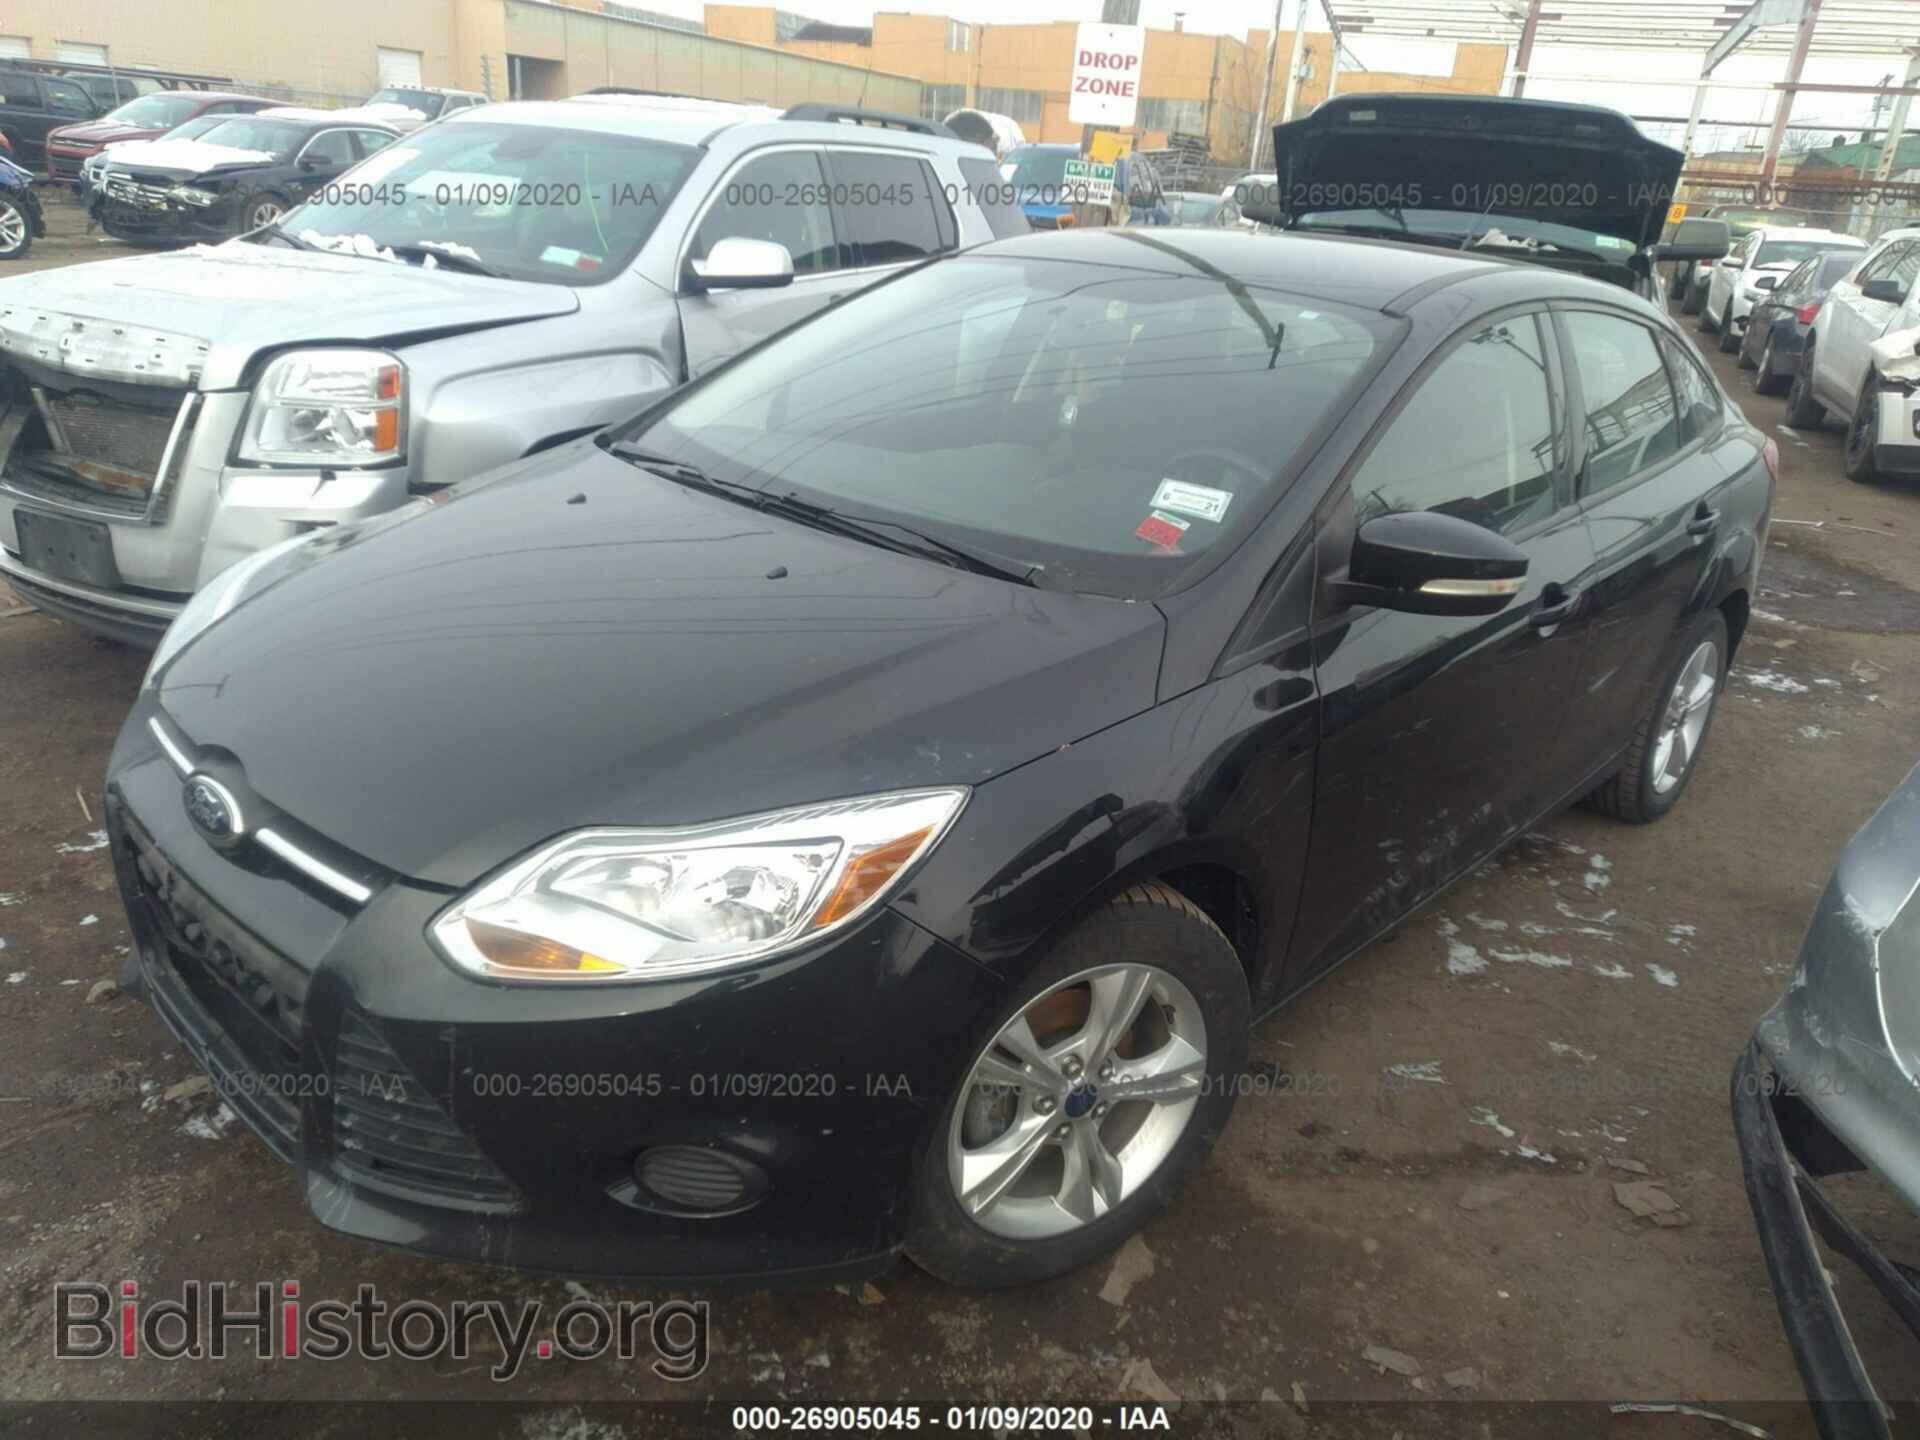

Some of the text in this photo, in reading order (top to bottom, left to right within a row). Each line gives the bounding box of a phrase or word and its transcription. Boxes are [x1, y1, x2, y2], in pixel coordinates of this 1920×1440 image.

[1078, 50, 1138, 71] DROP
[1074, 76, 1136, 98] ZONE
[1204, 502, 1219, 512] 21
